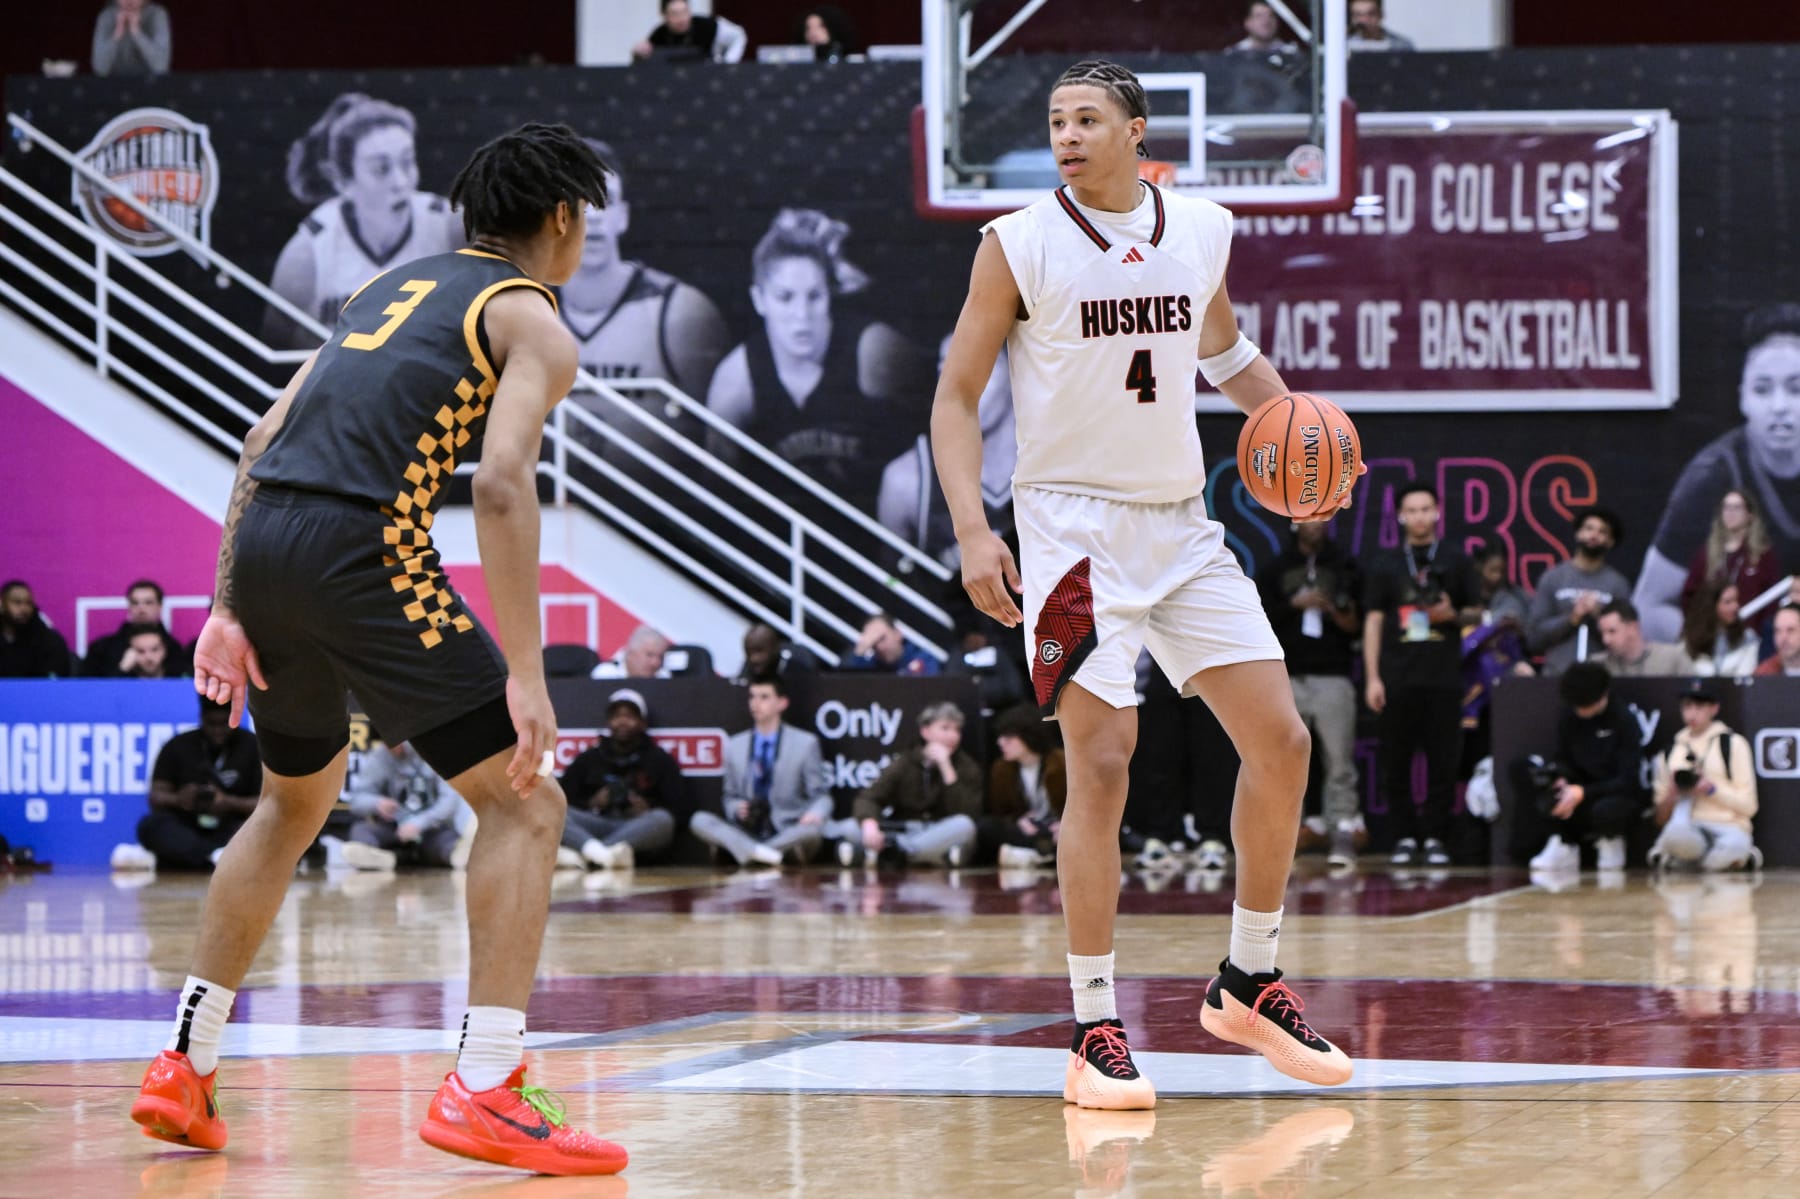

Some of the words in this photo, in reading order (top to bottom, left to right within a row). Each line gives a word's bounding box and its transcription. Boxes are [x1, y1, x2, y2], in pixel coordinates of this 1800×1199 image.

[1431, 161, 1619, 234] COLLEGE
[341, 279, 437, 351] 3
[1080, 295, 1192, 339] HUSKIES
[1356, 300, 1401, 369] OF
[1420, 299, 1641, 370] BASKETBALL
[1125, 349, 1157, 404] 4
[1299, 425, 1320, 505] SPALDING
[815, 700, 903, 746] Only
